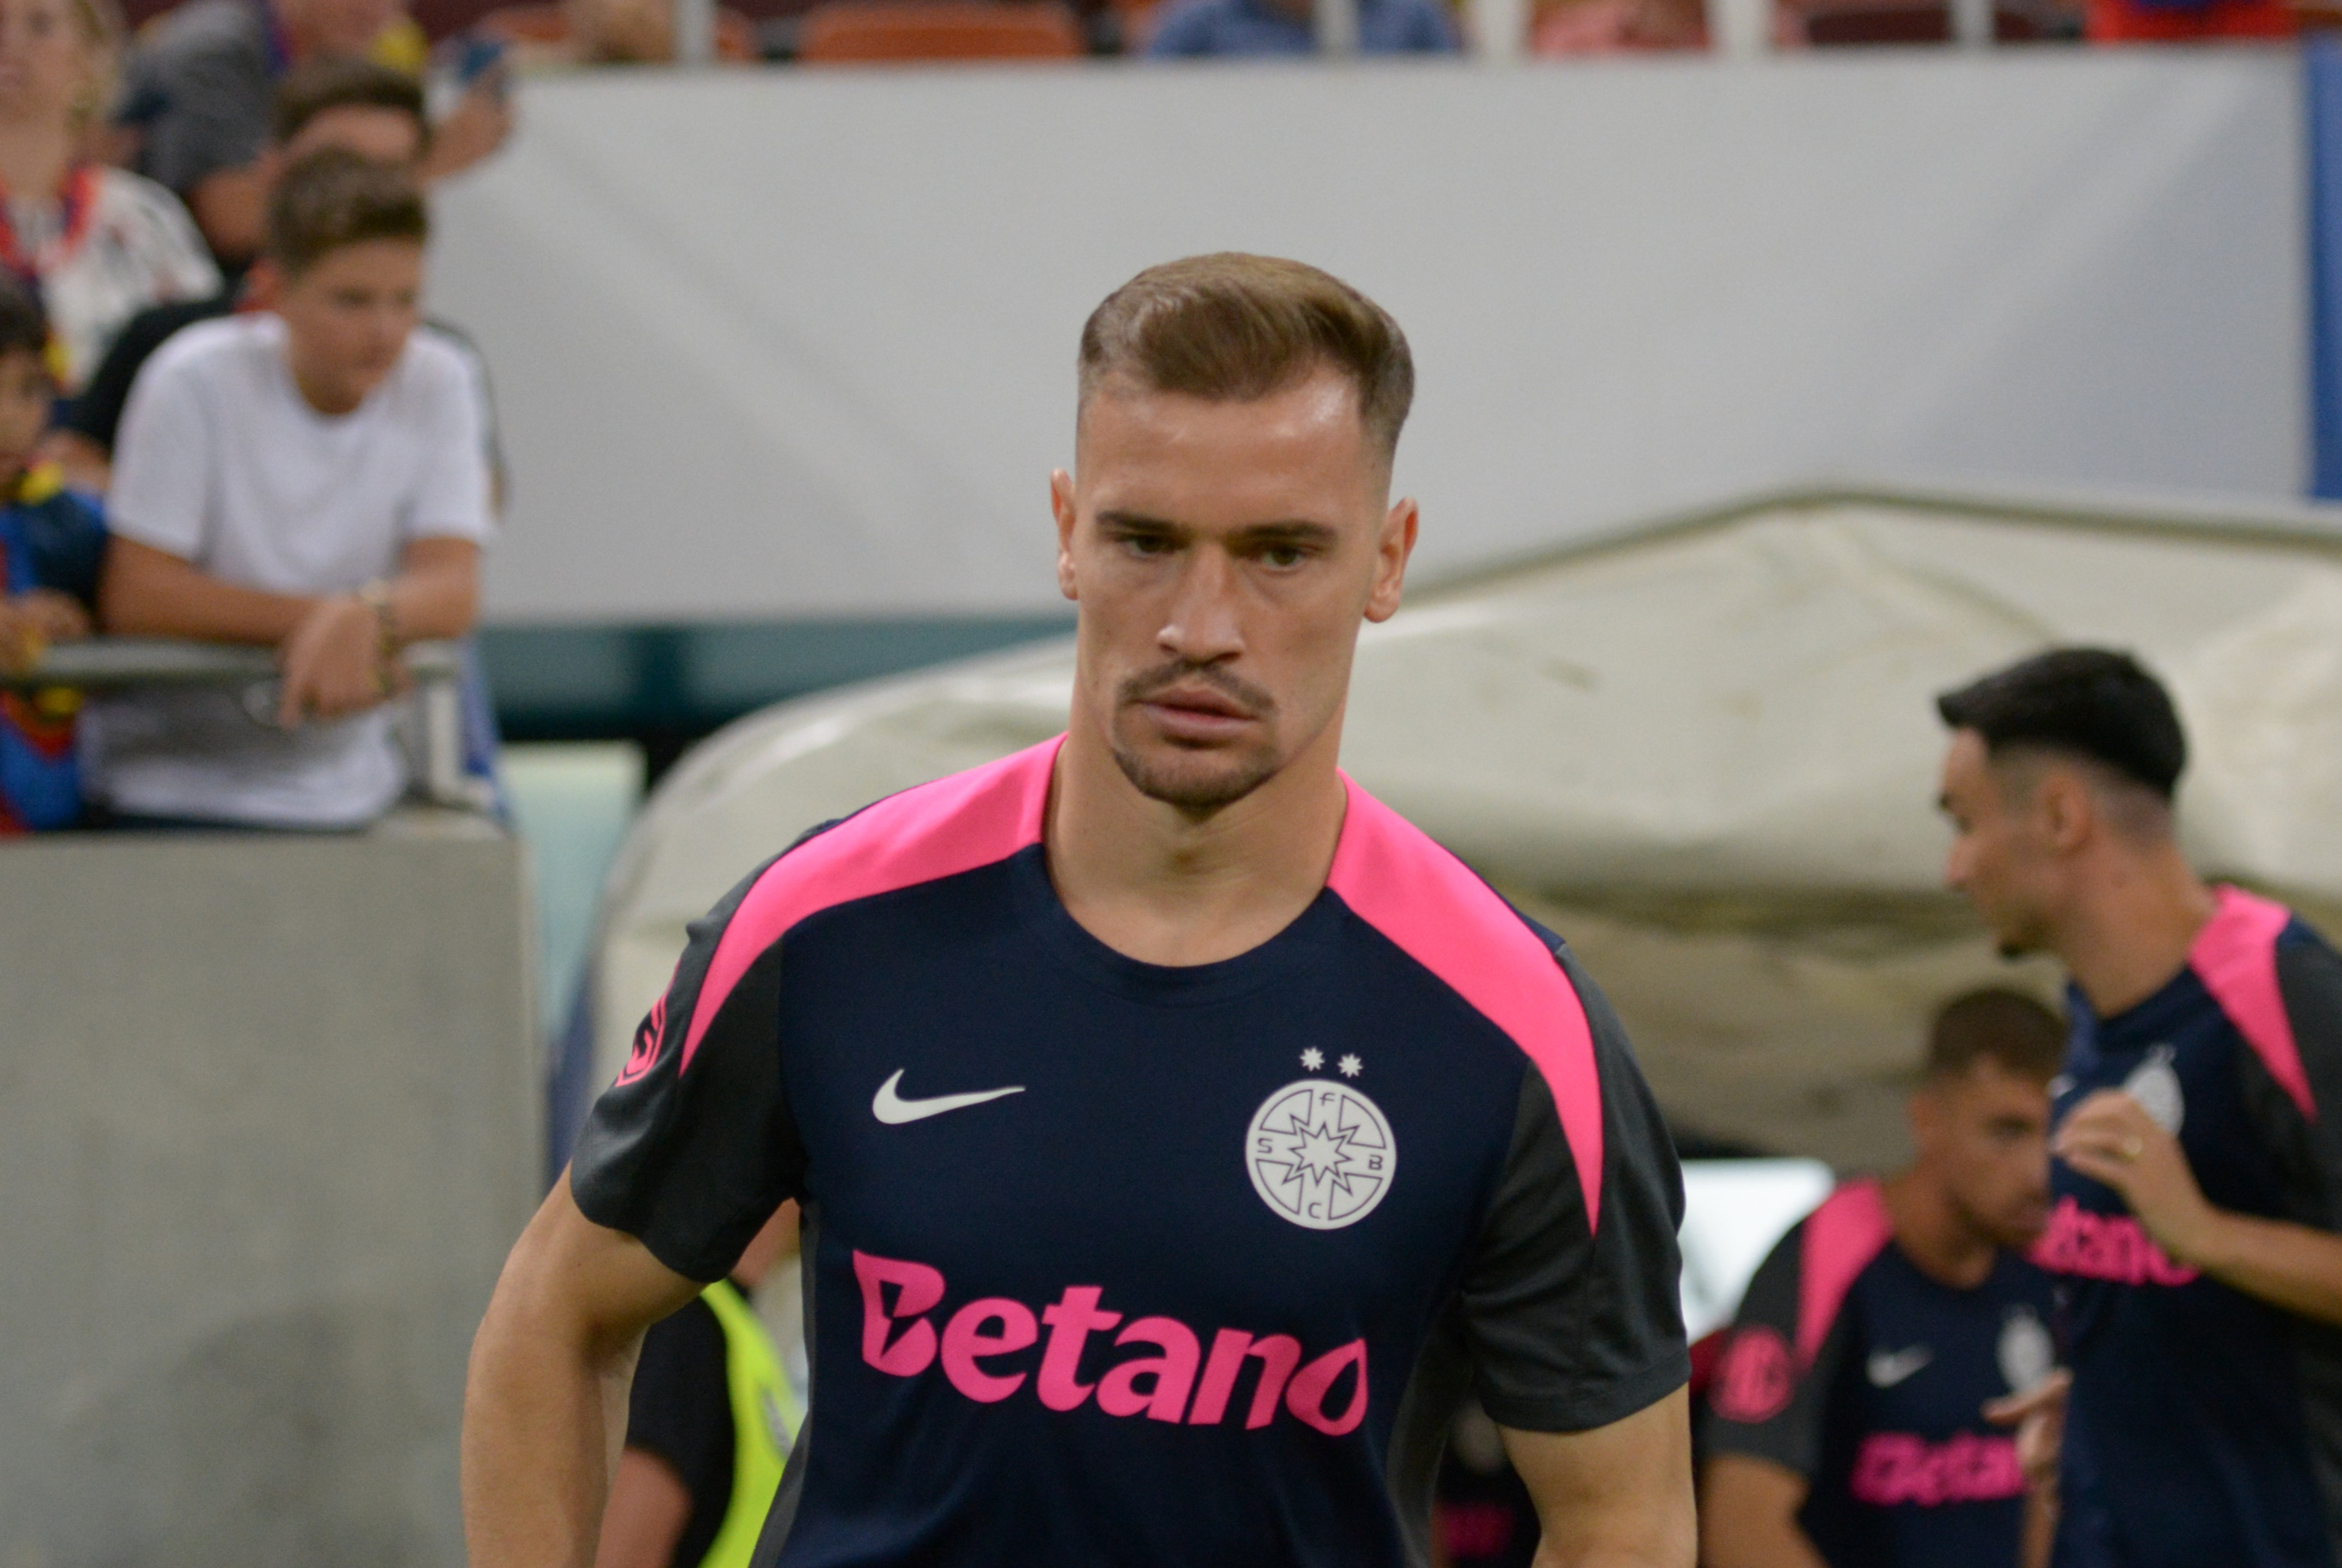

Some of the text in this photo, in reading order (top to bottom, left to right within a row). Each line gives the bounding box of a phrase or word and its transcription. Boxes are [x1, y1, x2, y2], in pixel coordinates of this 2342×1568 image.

[1319, 1092, 1335, 1106] F
[1257, 1137, 1273, 1154] S
[1368, 1154, 1383, 1171] B
[1308, 1202, 1321, 1219] C
[853, 1249, 1368, 1436] Betano
